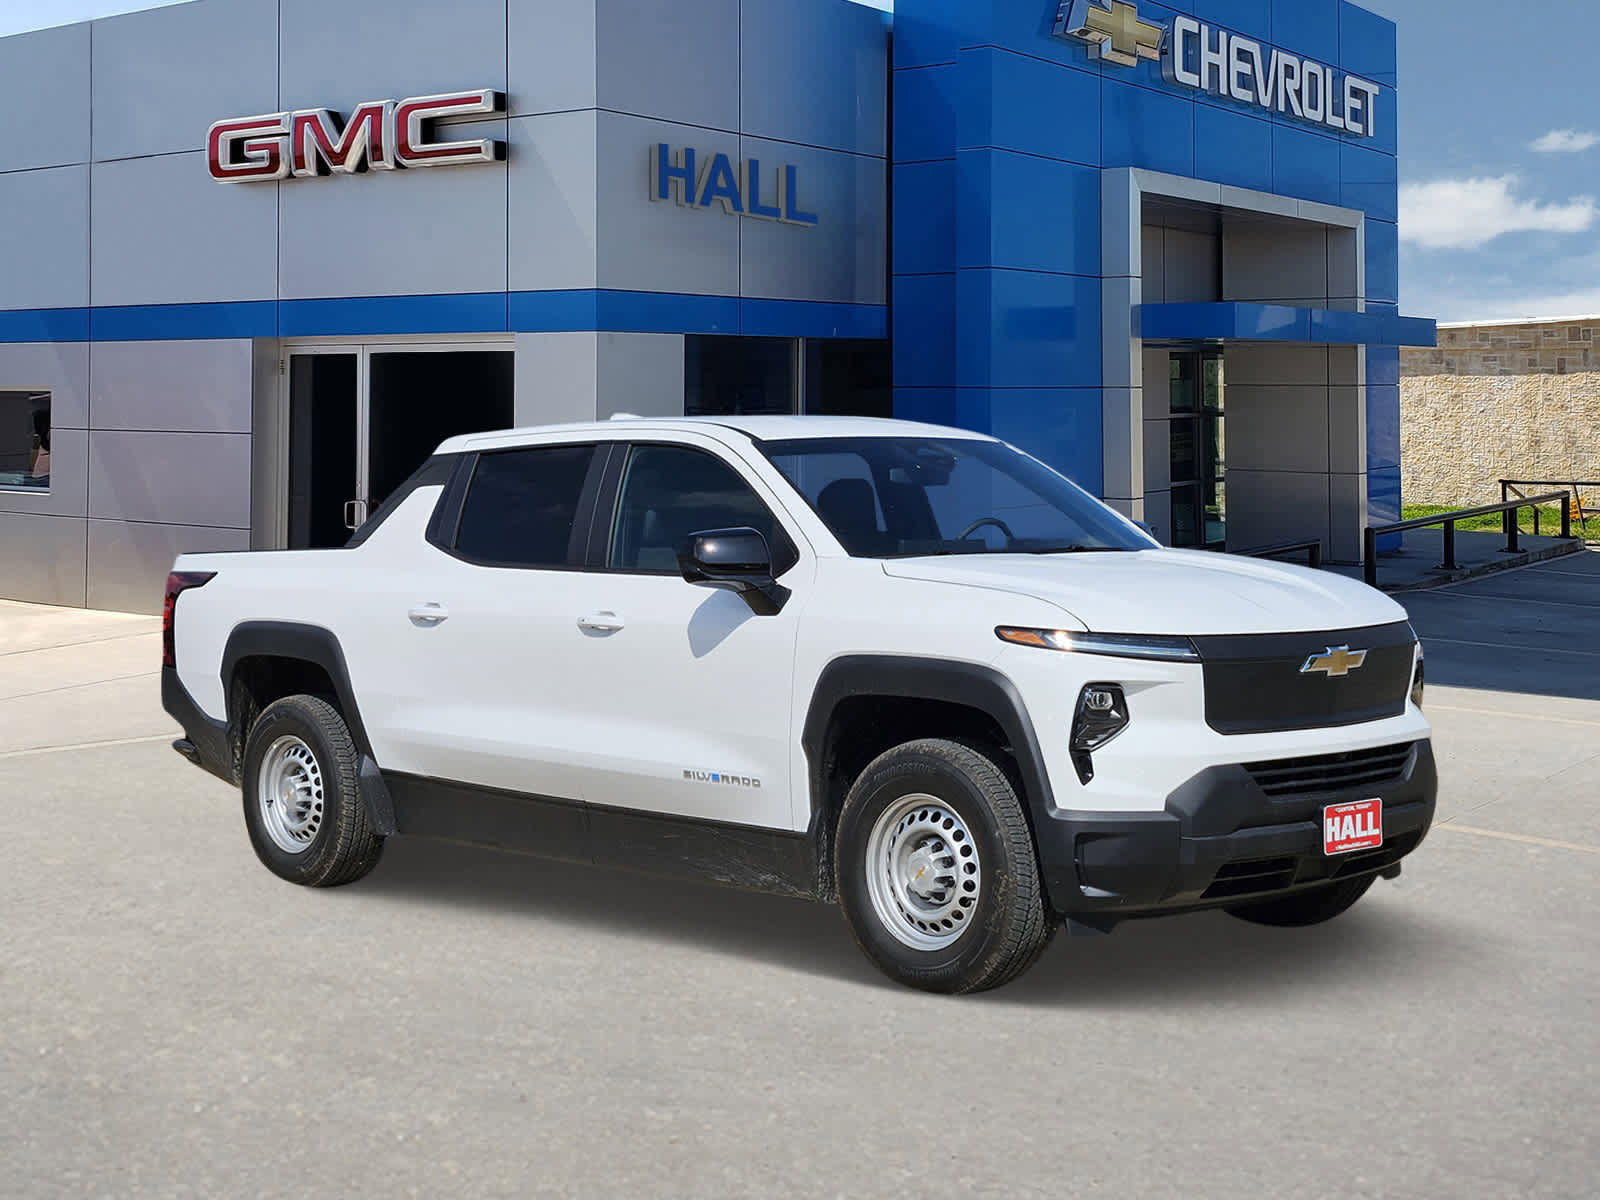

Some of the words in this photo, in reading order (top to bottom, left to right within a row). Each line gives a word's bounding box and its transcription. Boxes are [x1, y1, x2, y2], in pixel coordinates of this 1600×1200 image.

[1174, 15, 1379, 137] CHEVROLET
[207, 88, 506, 184] GMC
[650, 143, 819, 226] HALL
[683, 769, 761, 788] SILVERADO
[1326, 811, 1380, 843] HALL
